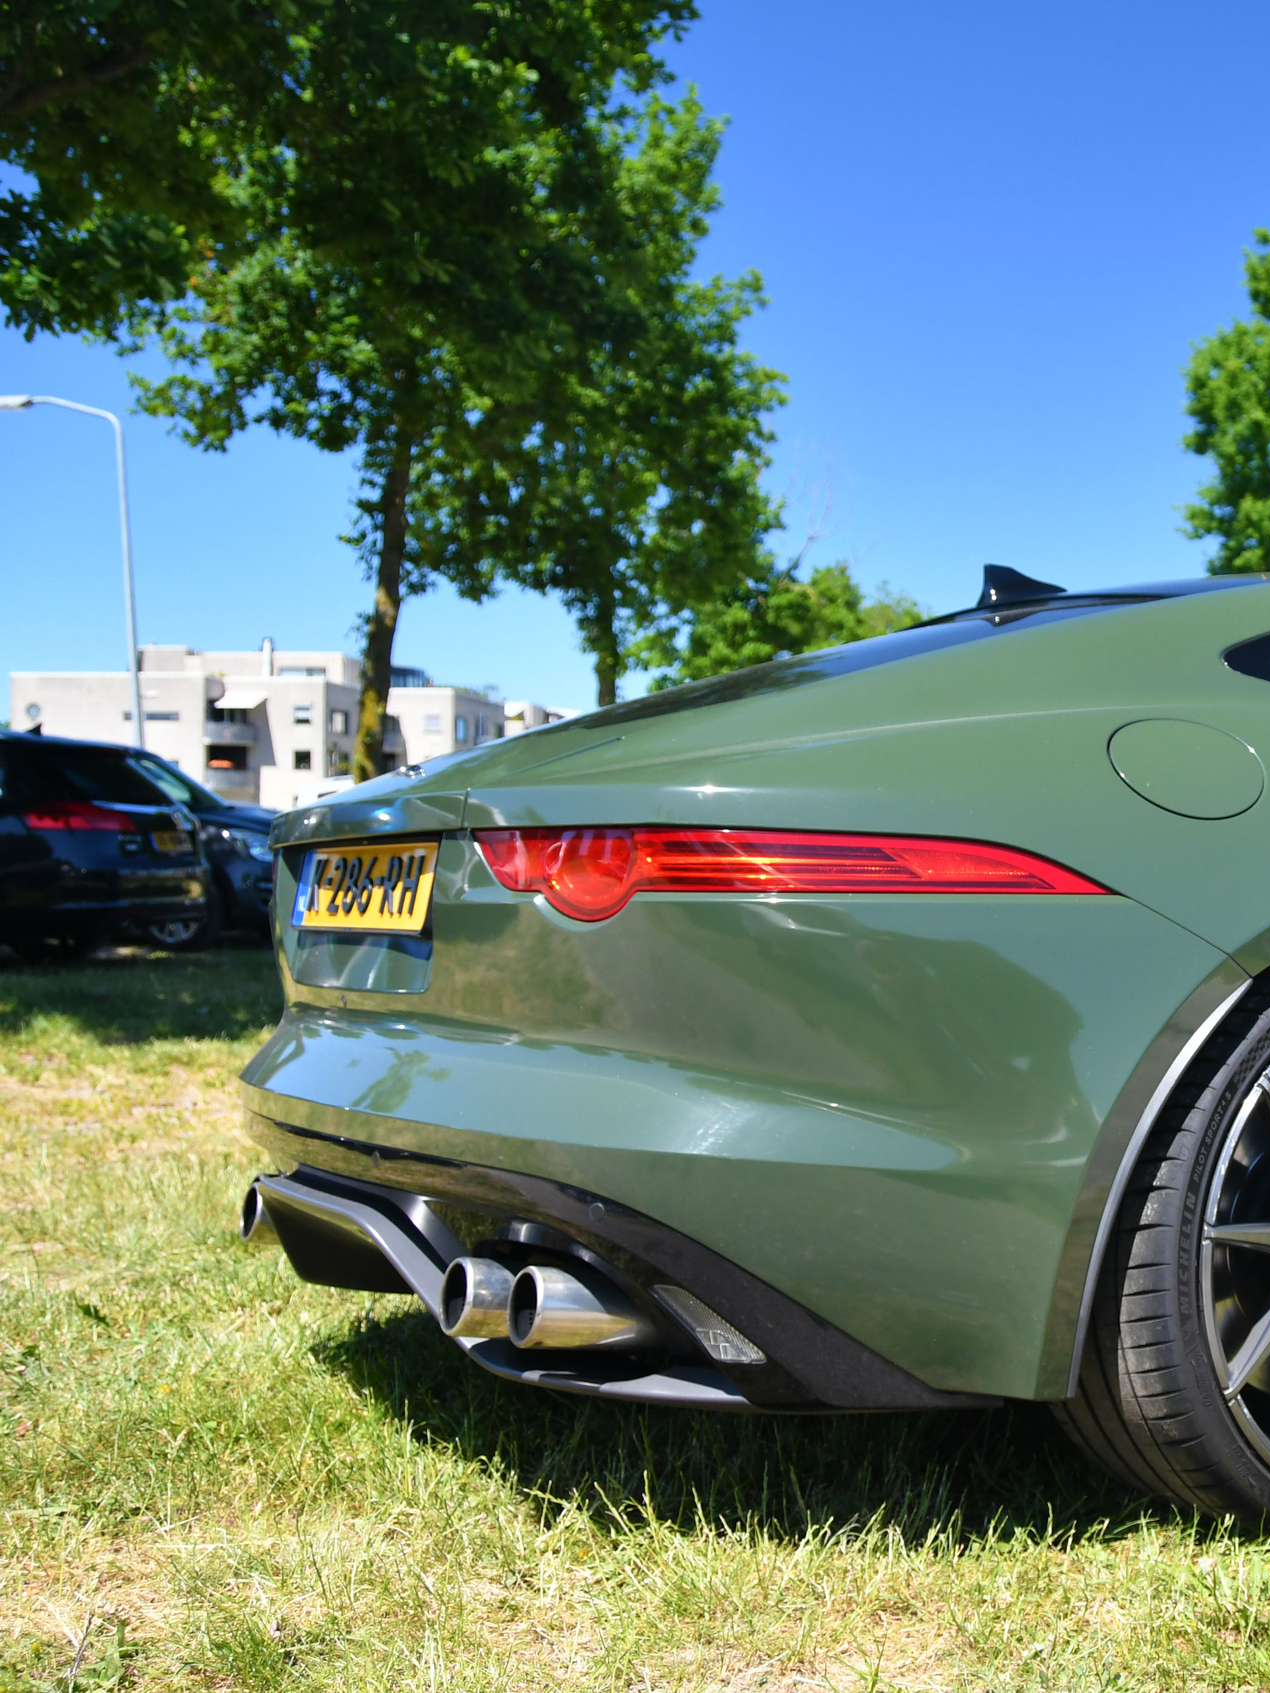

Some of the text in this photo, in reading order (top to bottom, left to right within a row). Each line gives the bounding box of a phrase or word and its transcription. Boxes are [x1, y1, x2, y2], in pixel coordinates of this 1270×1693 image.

[306, 855, 426, 915] K-286-RH
[1179, 1191, 1197, 1315] MICHELIN
[1193, 1146, 1208, 1183] PILOT
